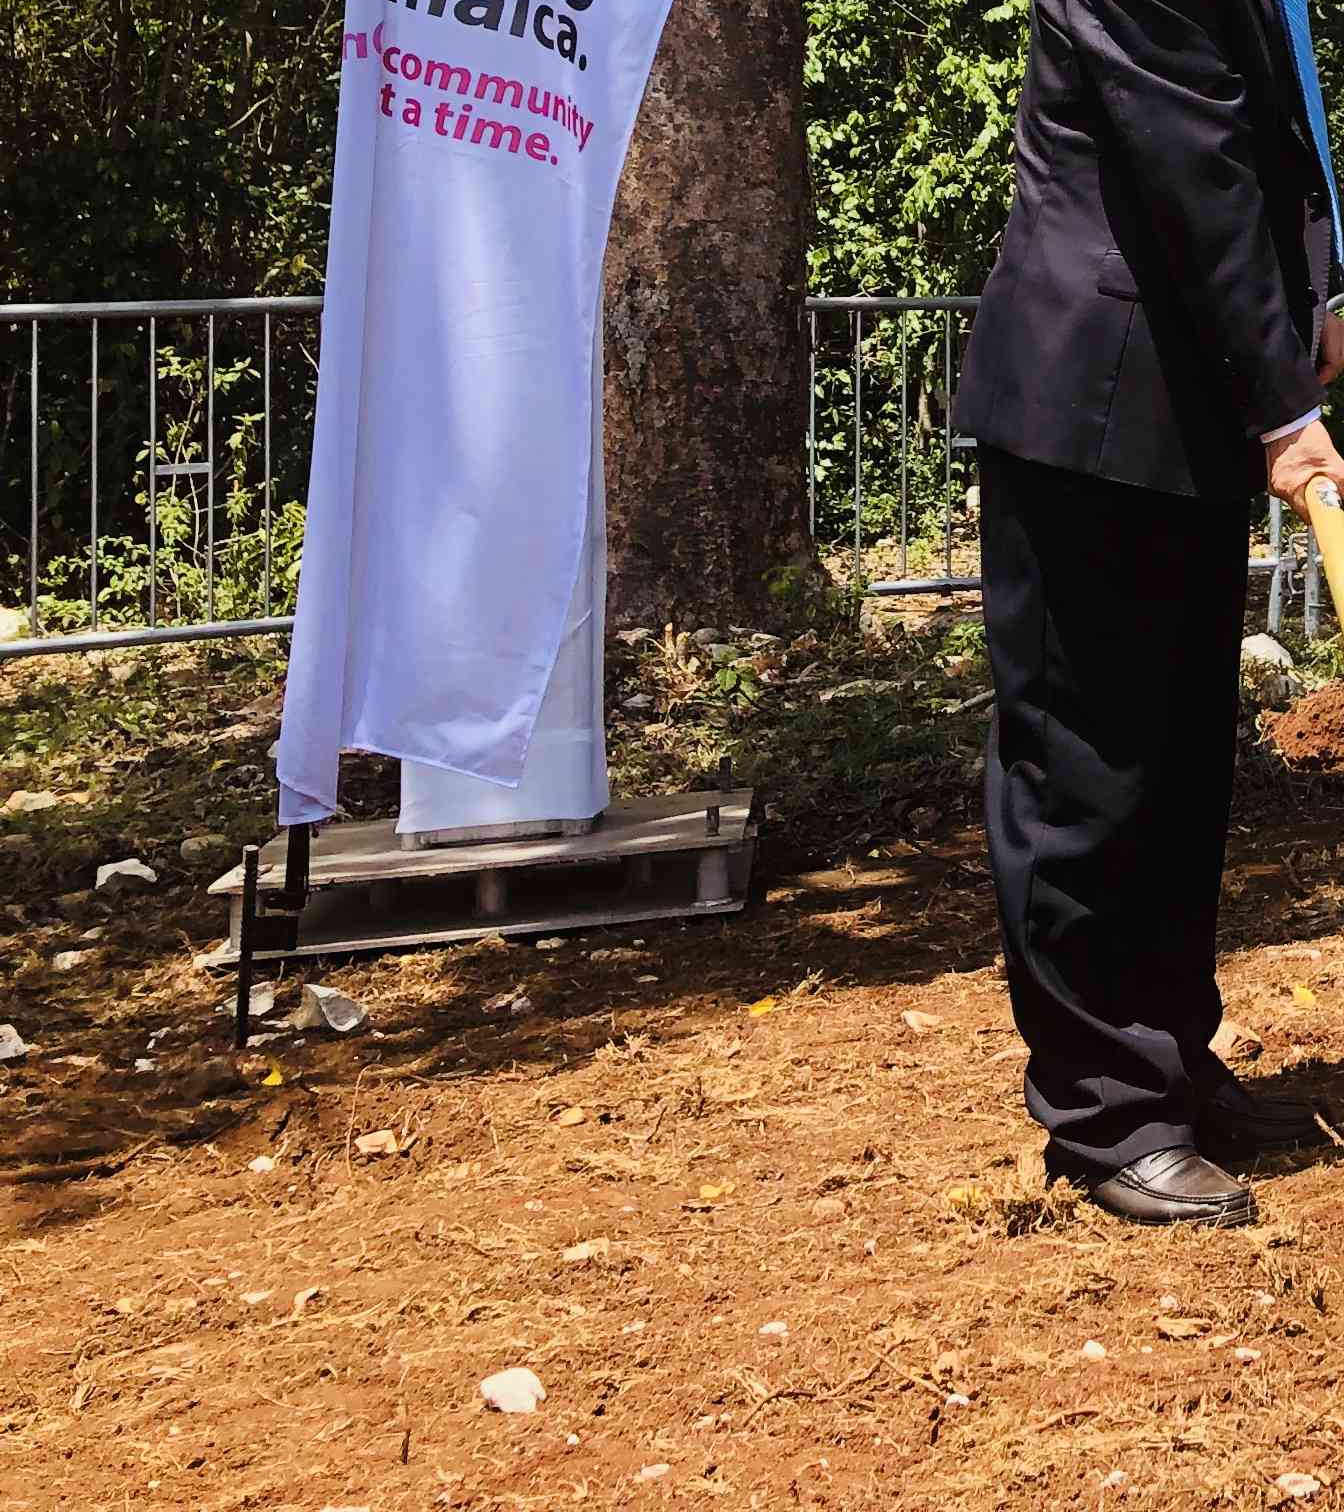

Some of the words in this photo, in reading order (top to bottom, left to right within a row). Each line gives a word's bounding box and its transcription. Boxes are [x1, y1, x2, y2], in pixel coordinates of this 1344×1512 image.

[382, 43, 595, 153] community
[401, 97, 422, 128] a
[433, 100, 560, 167] time.
